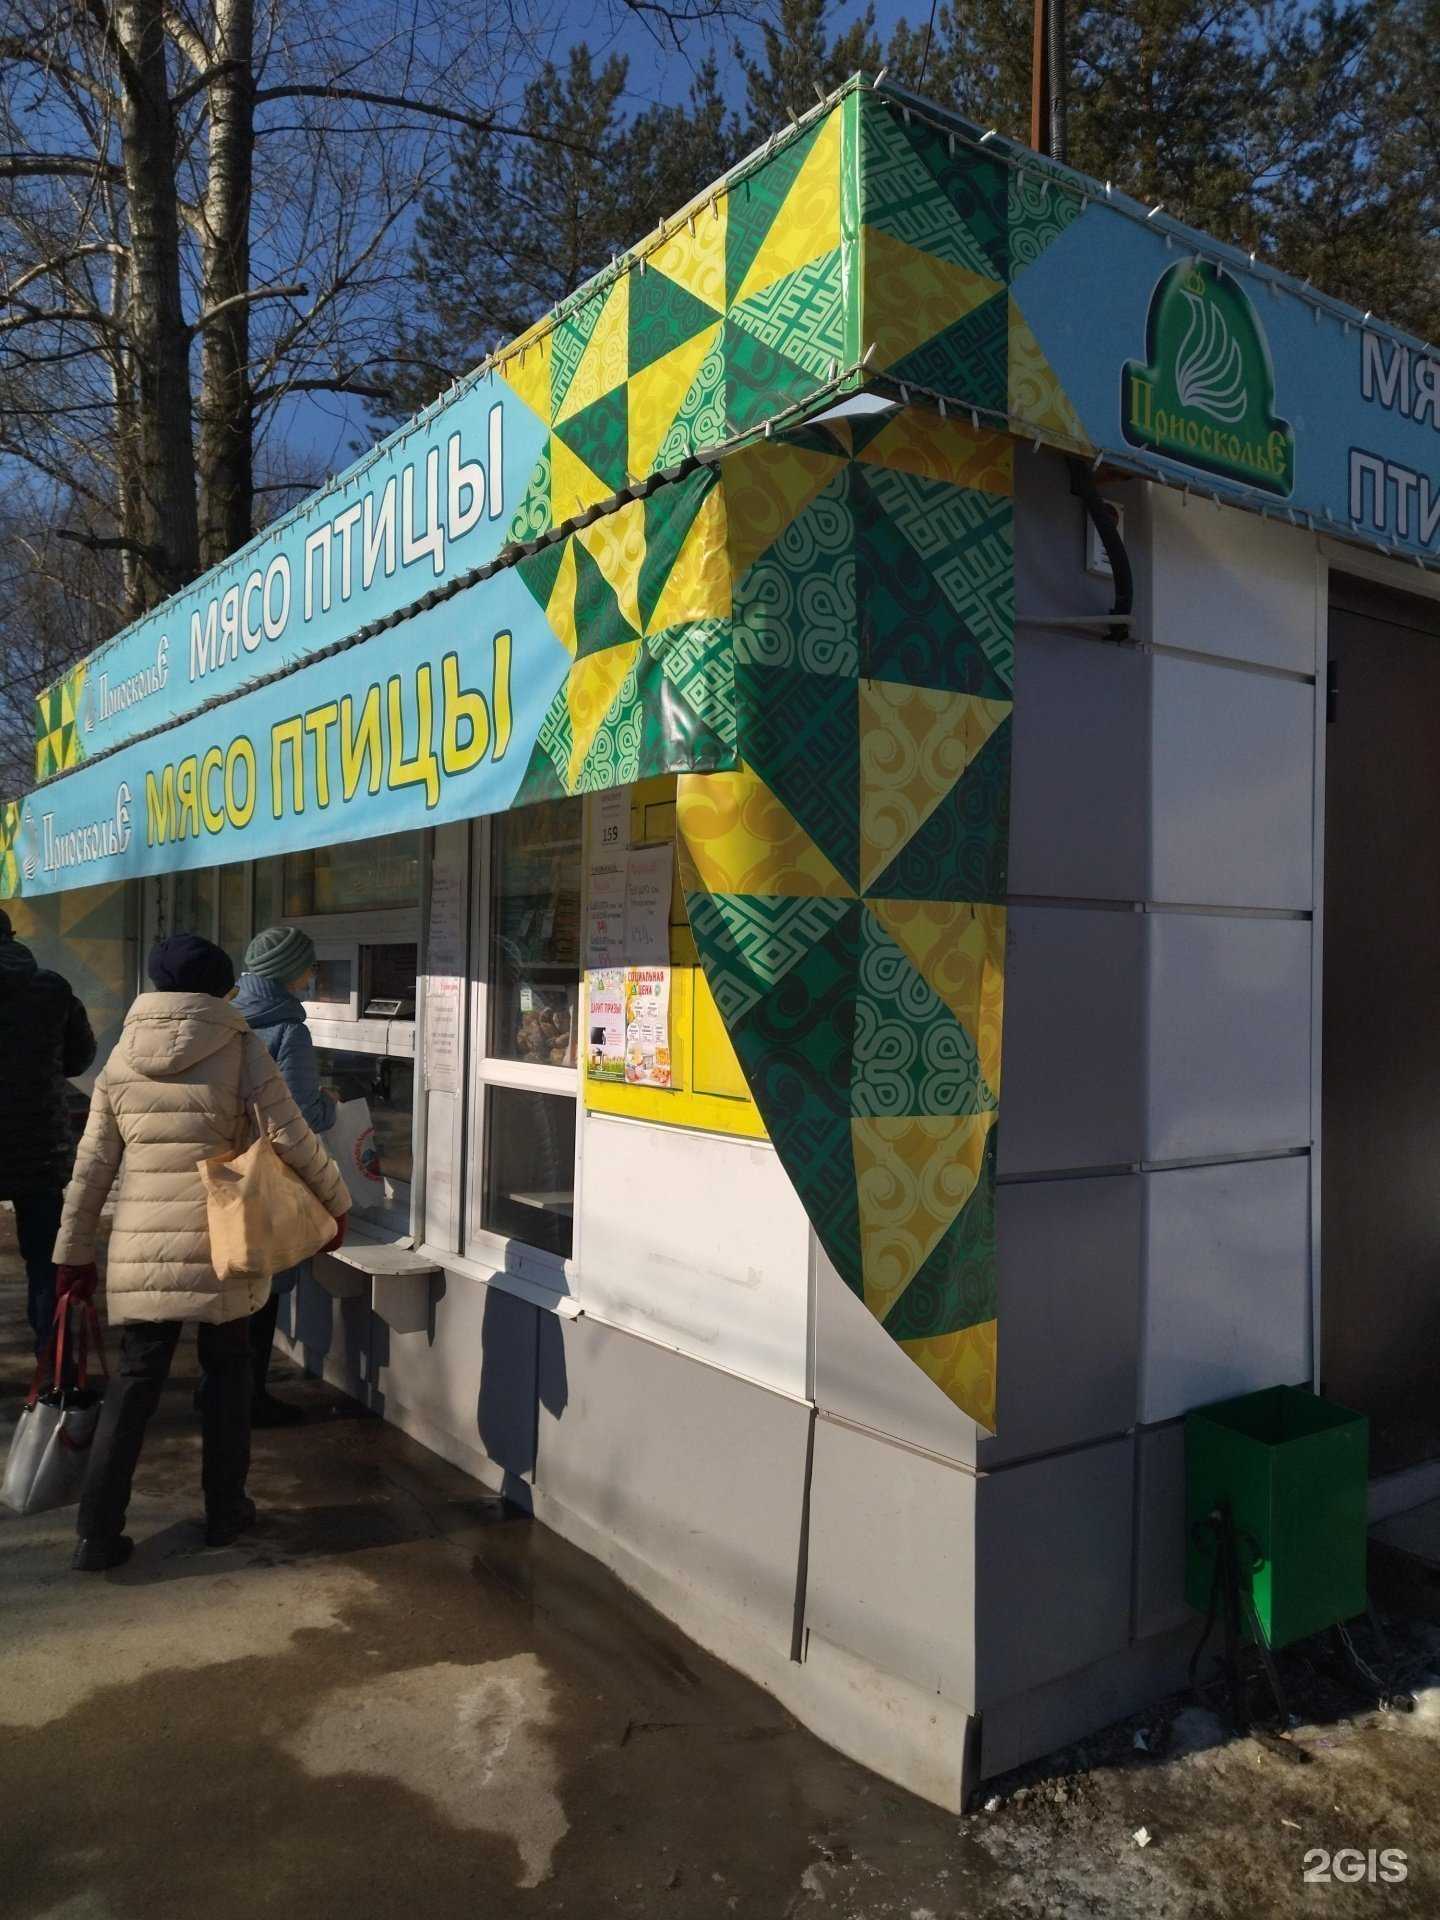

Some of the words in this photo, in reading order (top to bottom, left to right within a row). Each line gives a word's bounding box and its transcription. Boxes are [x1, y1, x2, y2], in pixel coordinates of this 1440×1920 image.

[189, 552, 291, 683] МЯСО
[303, 400, 505, 621] ПТИЦЫ
[145, 735, 257, 848] МЯСО
[271, 628, 513, 809] ПТИЦЫ
[627, 970, 665, 983] СОЦИАЛЬНАЯ
[638, 984, 653, 996] ЦЕНА
